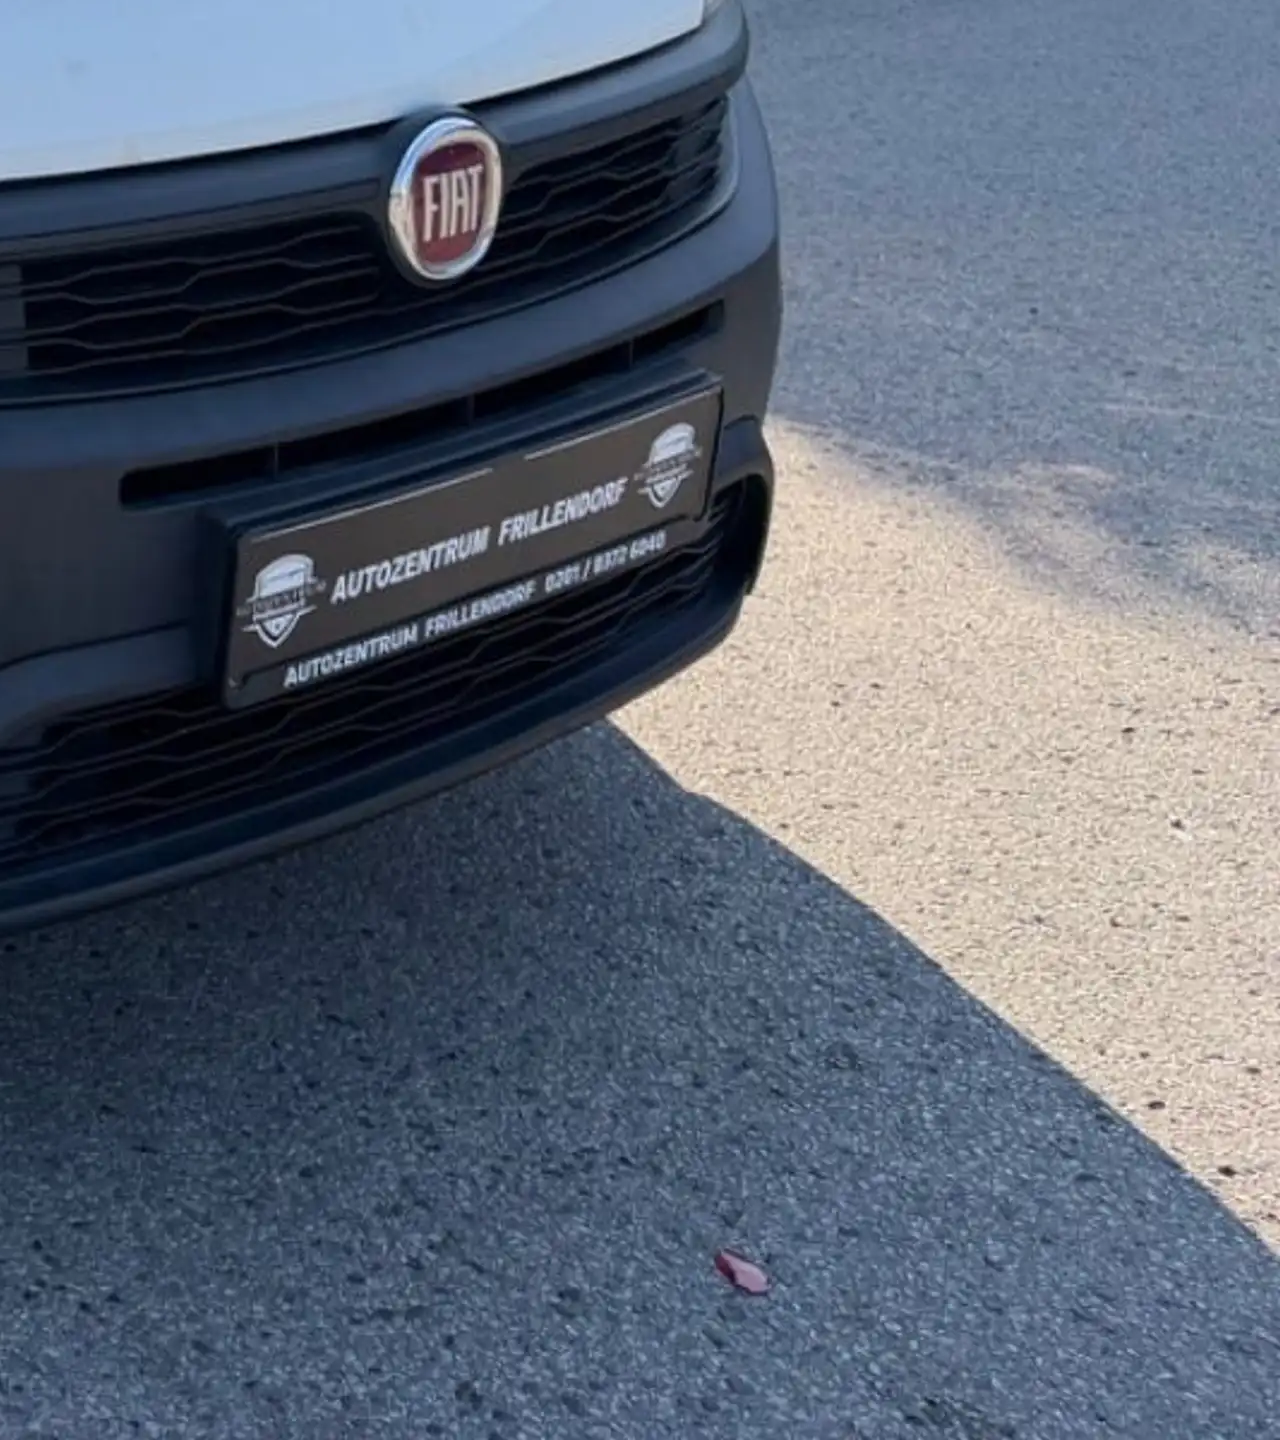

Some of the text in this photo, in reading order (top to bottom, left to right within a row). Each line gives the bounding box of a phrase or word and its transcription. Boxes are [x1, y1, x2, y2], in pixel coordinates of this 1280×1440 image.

[422, 163, 484, 243] FIAT
[330, 525, 491, 605] AUTOZENTRUM
[497, 476, 629, 547] FRILLENDORF
[283, 622, 418, 690] AUTOZENTRUM
[424, 578, 537, 640] FRILLENDORF
